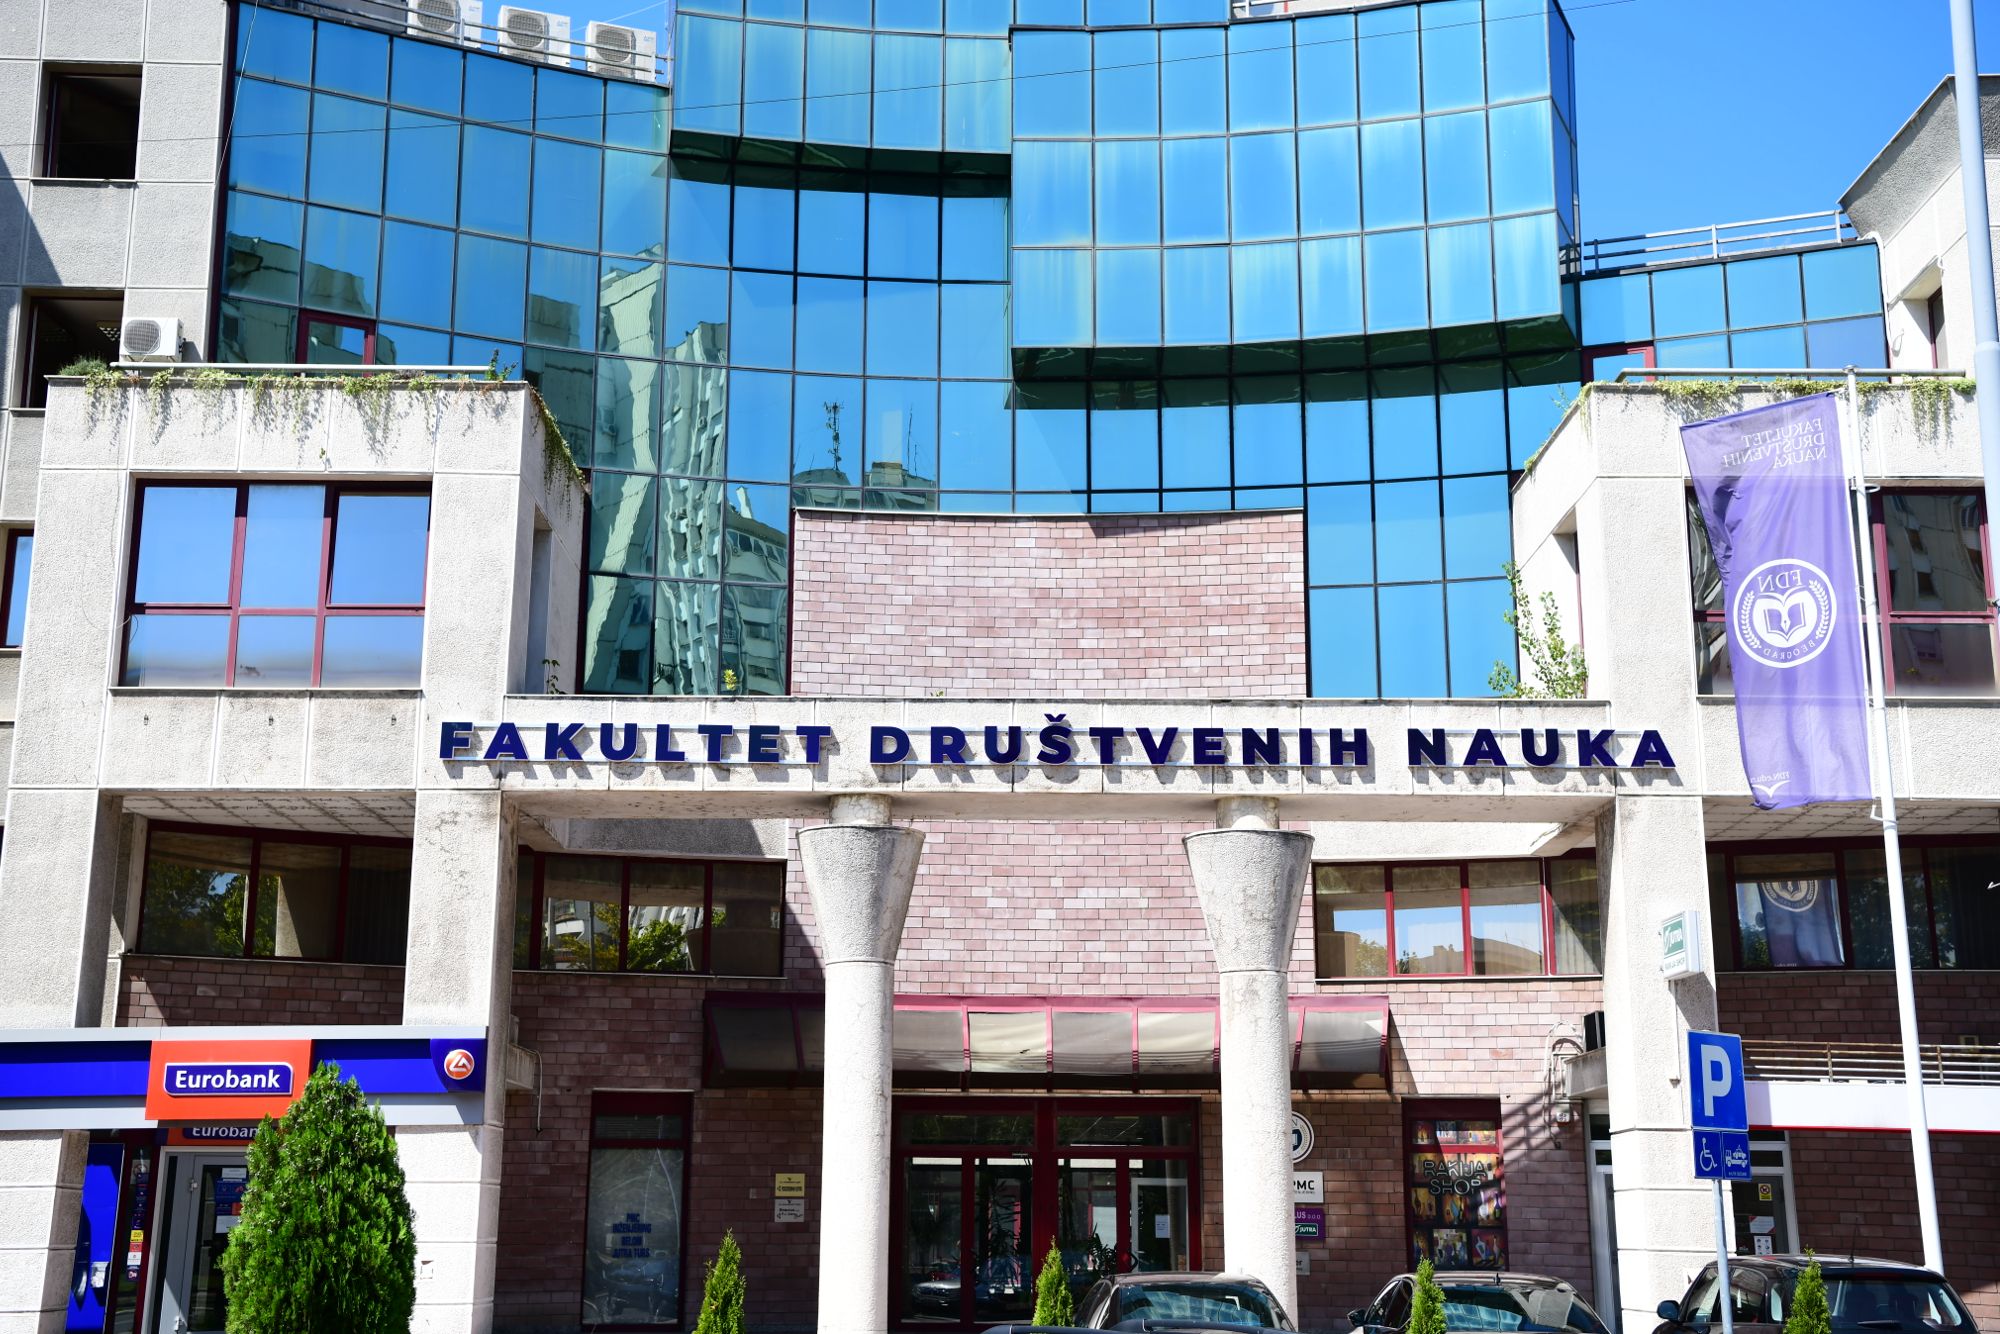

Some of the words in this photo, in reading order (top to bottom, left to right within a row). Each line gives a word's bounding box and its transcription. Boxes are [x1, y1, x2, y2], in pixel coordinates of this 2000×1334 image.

[439, 721, 832, 764] FAKULTET
[869, 713, 1368, 766] DRUŠTVENIH
[1407, 728, 1676, 767] NAUKA
[175, 1069, 280, 1089] Eurobank
[1700, 1043, 1733, 1117] P
[192, 1126, 259, 1138] Euroban
[1424, 1161, 1486, 1177] RAKIJA
[1430, 1179, 1481, 1194] SHOP
